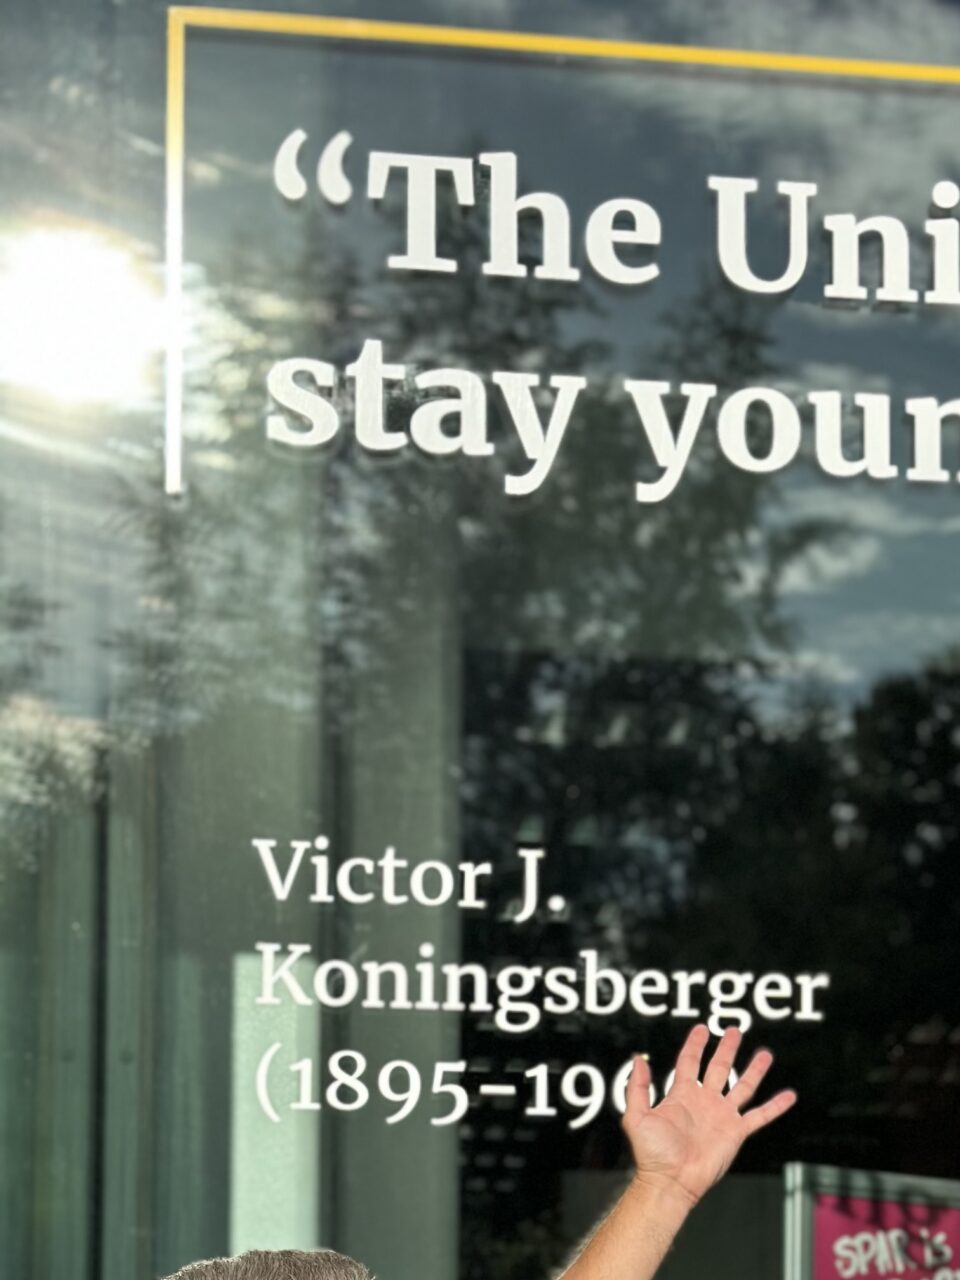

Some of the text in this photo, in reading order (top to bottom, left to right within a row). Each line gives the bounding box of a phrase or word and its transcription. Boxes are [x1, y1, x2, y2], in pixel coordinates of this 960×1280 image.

[266, 339, 587, 496] stay
[252, 835, 566, 923] Victor J.
[255, 942, 830, 1038] Koningsberger
[920, 1227, 953, 1269] is
